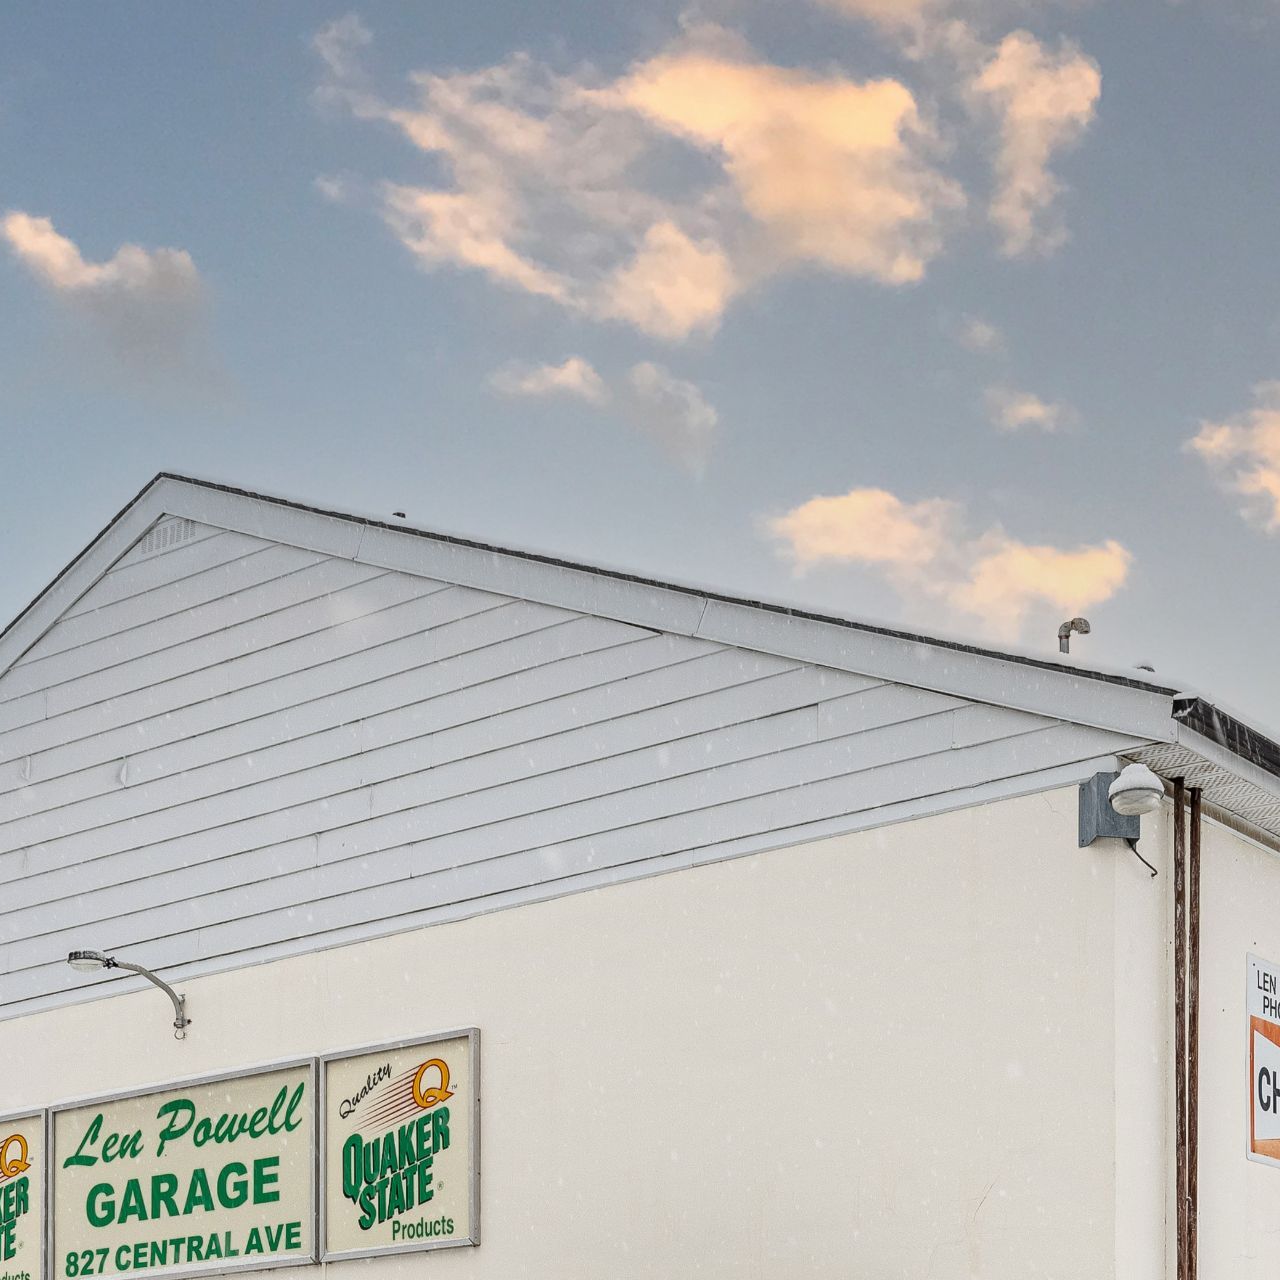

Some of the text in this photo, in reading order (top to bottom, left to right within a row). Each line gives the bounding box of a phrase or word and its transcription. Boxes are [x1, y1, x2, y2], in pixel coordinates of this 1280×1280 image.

[1257, 970, 1277, 995] LEN
[339, 1063, 392, 1119] Quality
[63, 1082, 305, 1169] Len Powell
[343, 1106, 450, 1205] QUAKER
[86, 1156, 280, 1227] GARAGE
[358, 1156, 434, 1230] STATE
[65, 1222, 301, 1277] 827 CENTRAL AVE
[392, 1216, 454, 1240] Products
